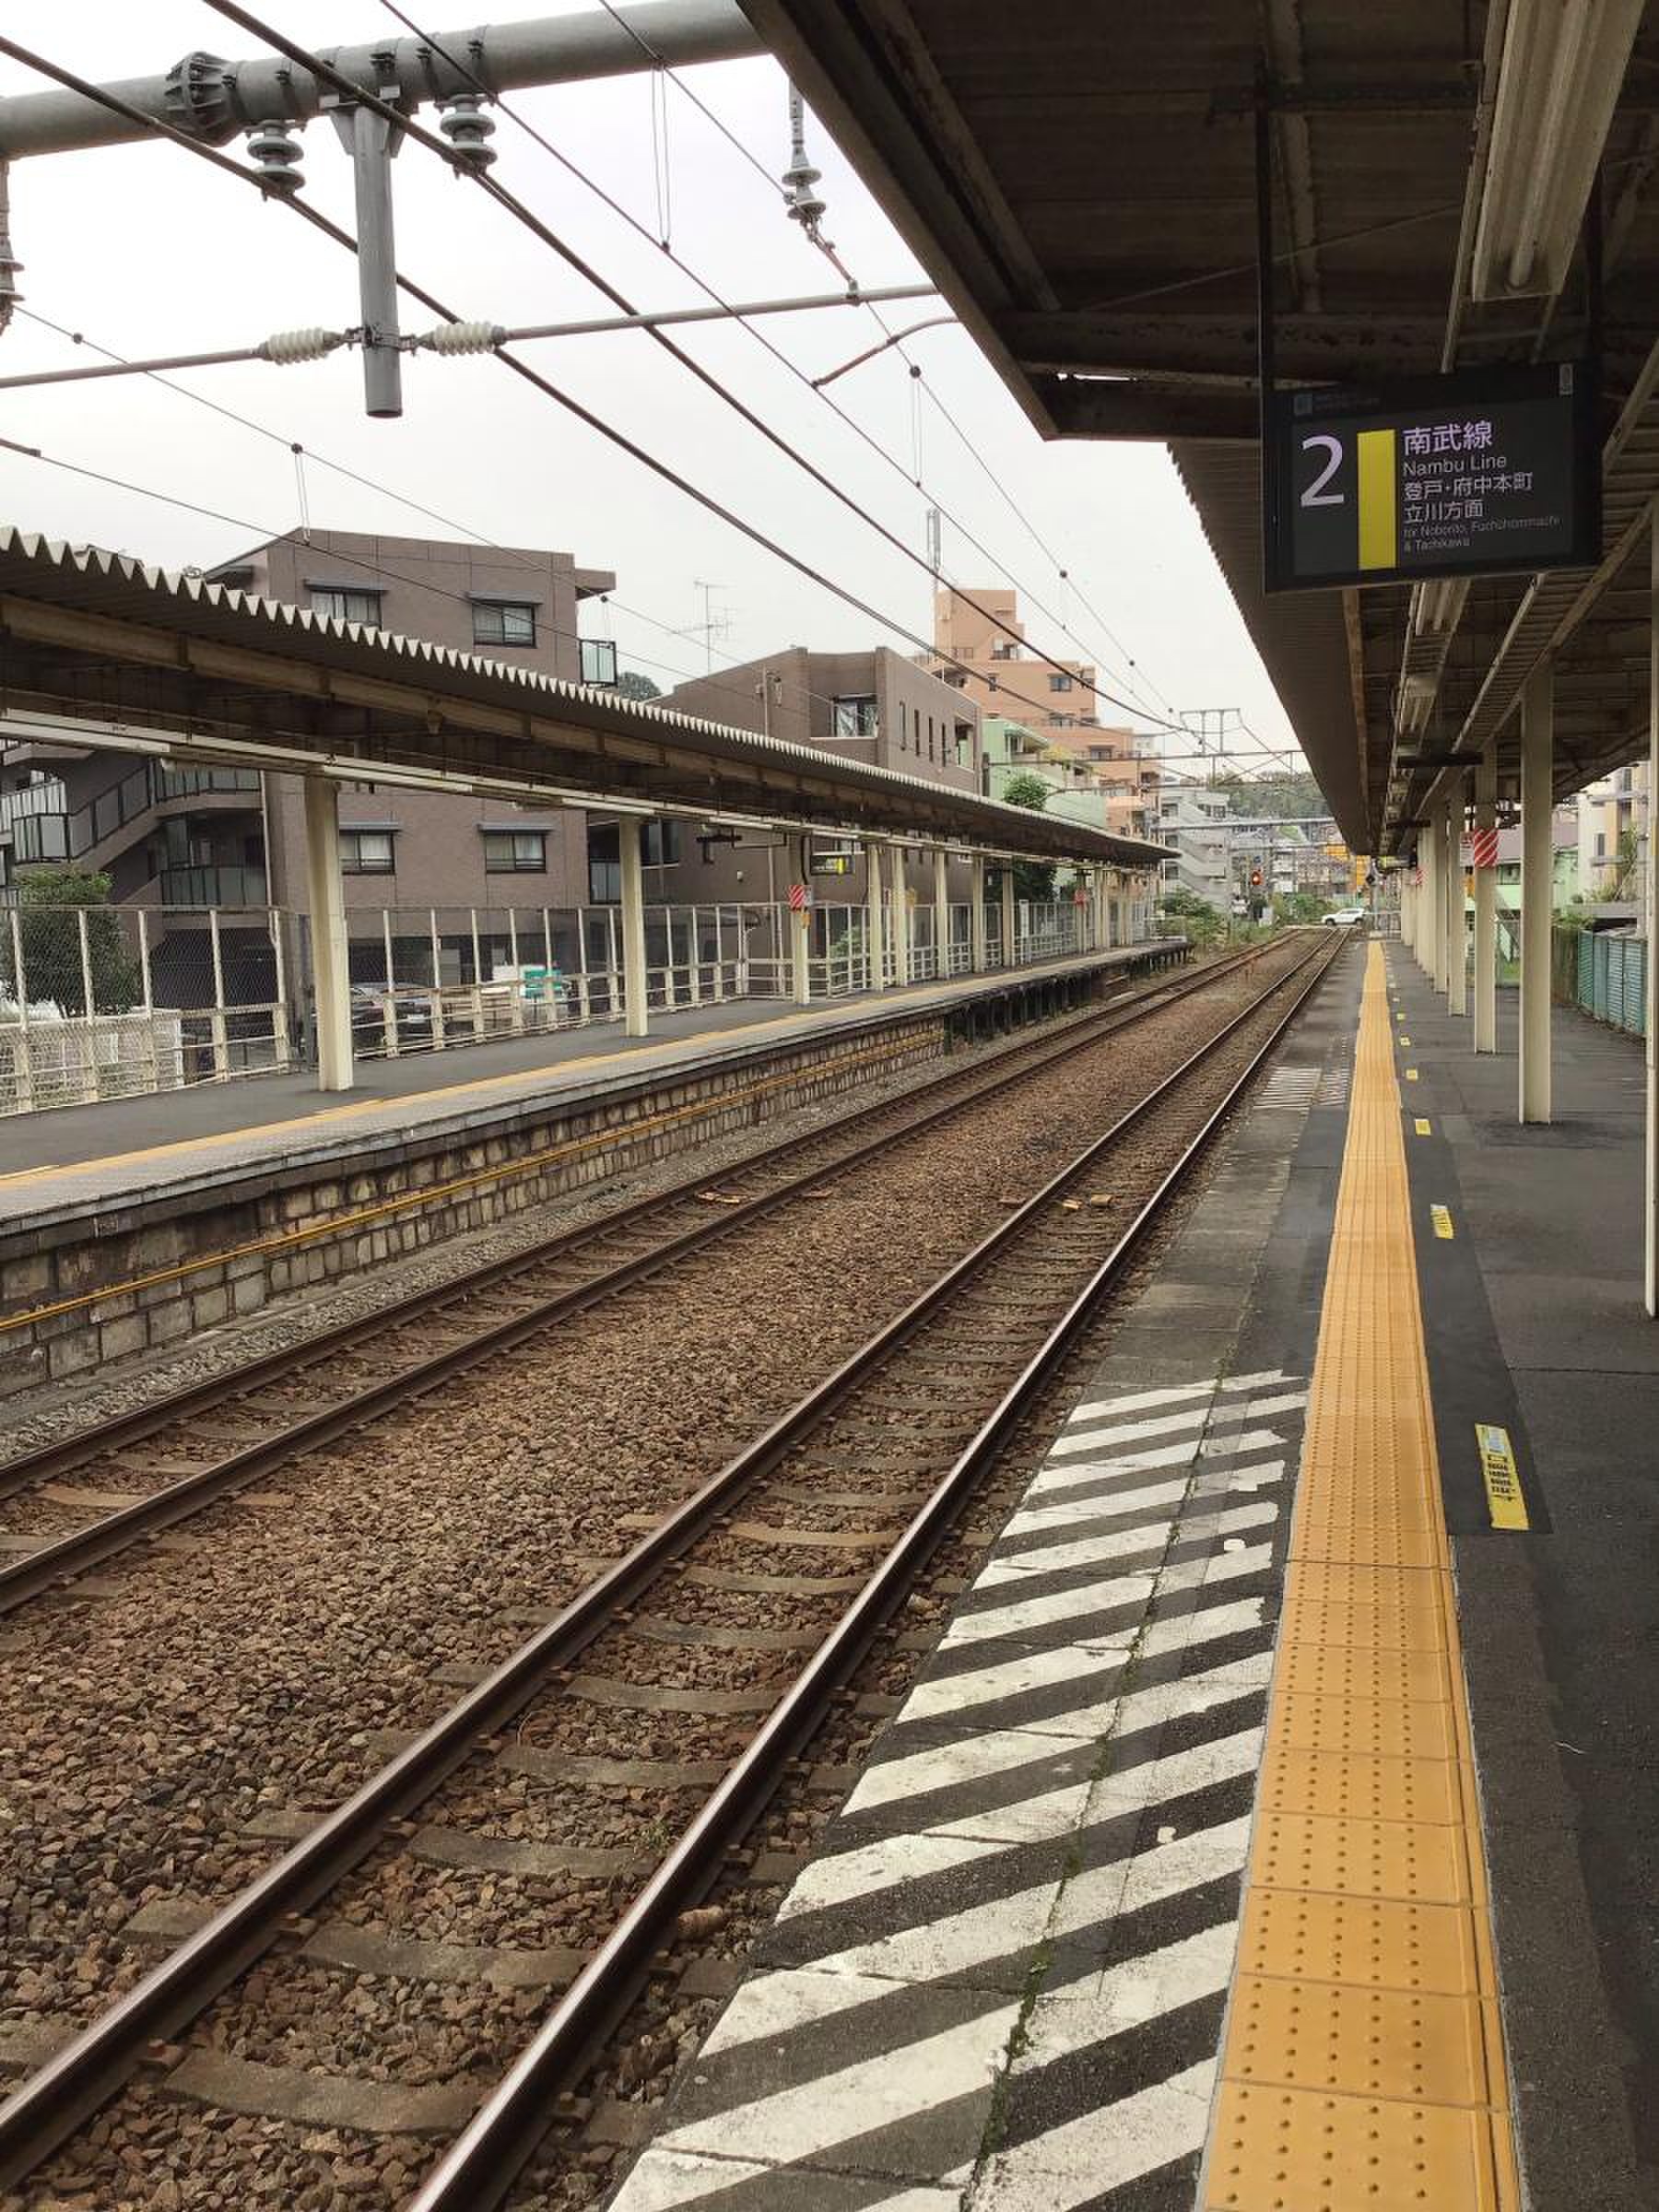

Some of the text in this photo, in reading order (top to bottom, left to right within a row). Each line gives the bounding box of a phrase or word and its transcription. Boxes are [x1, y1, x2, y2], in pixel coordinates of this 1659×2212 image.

[1403, 420, 1493, 456] 南武線
[1300, 434, 1345, 508] 2
[1403, 455, 1508, 477] Nambu Line
[1404, 499, 1484, 524] 立川方面
